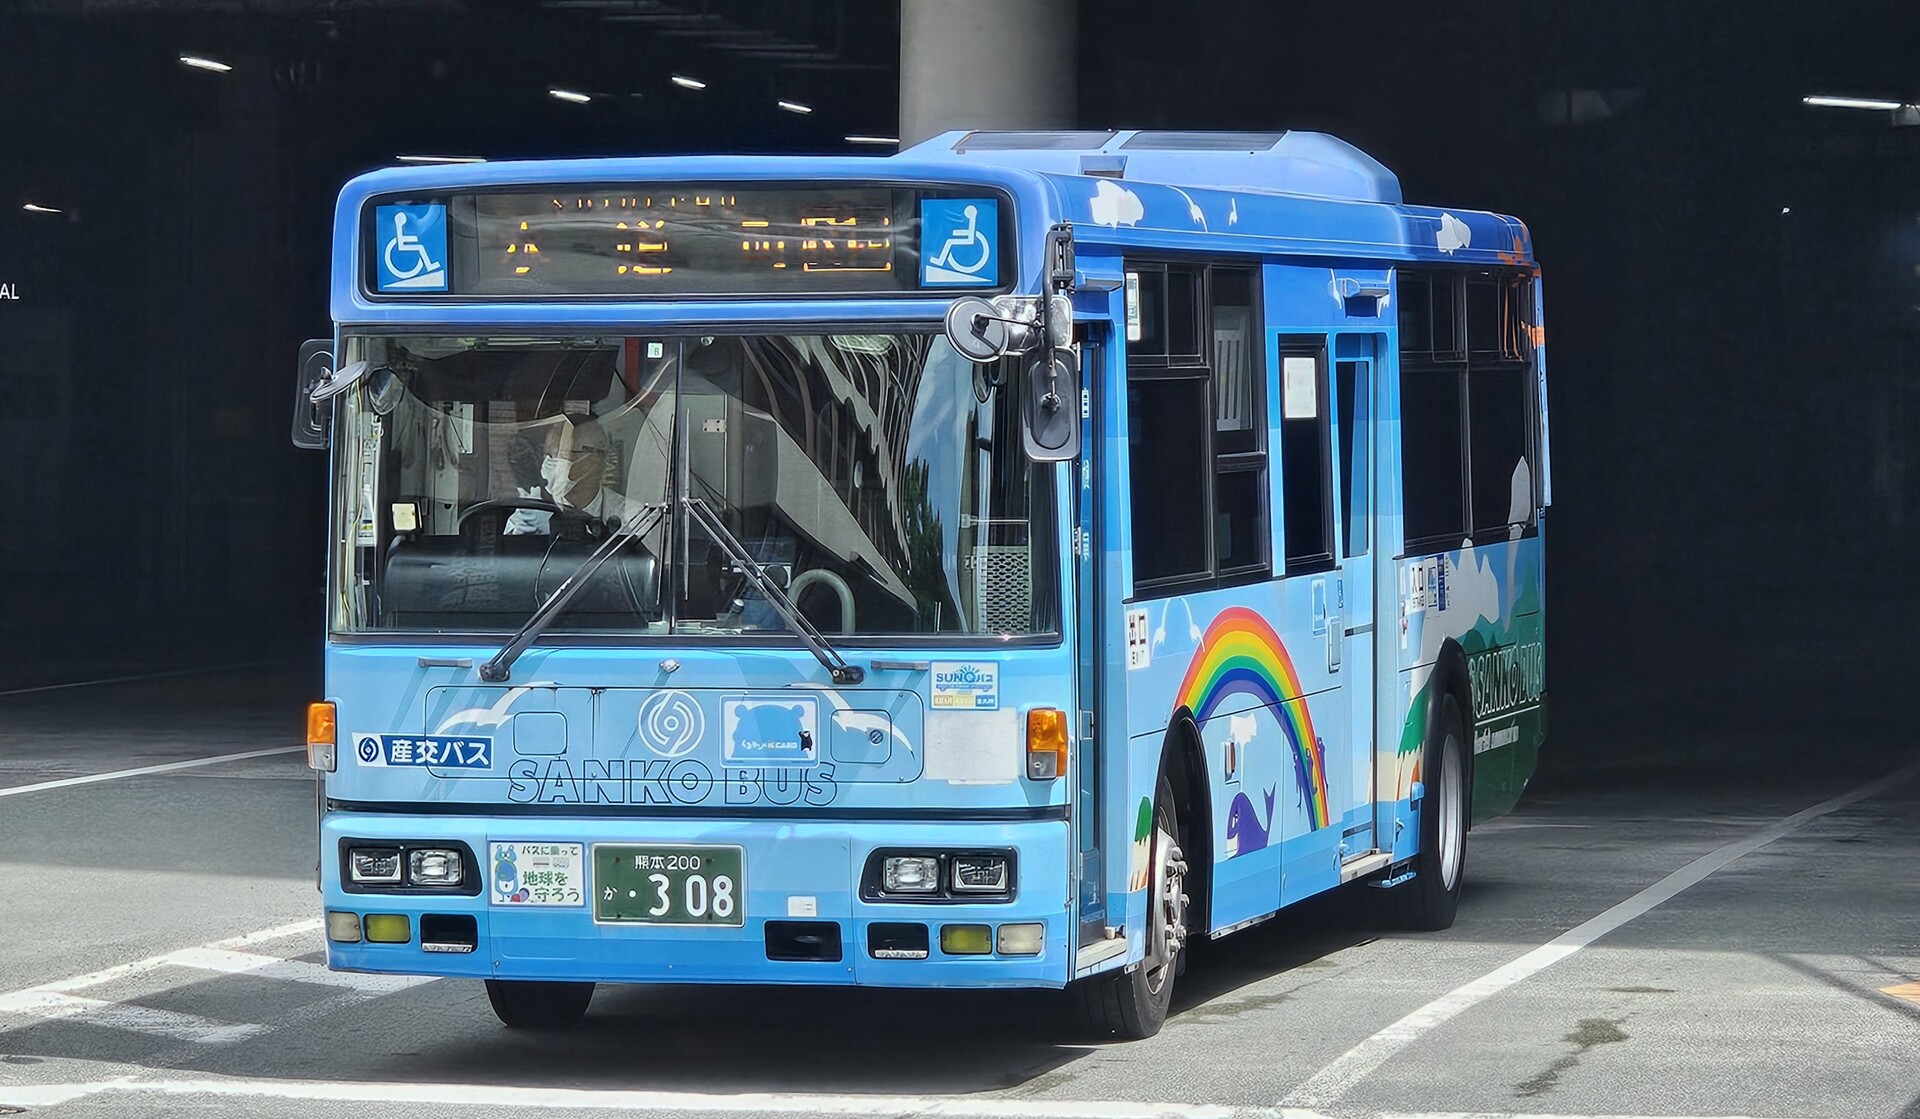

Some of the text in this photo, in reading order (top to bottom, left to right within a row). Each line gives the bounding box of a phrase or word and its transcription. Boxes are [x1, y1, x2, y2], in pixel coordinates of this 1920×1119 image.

[390, 738, 490, 766] 産交バス
[507, 759, 838, 807] SANKO BUS
[522, 870, 569, 887] 地球を
[534, 887, 580, 902] 守ろう
[603, 886, 618, 901] か
